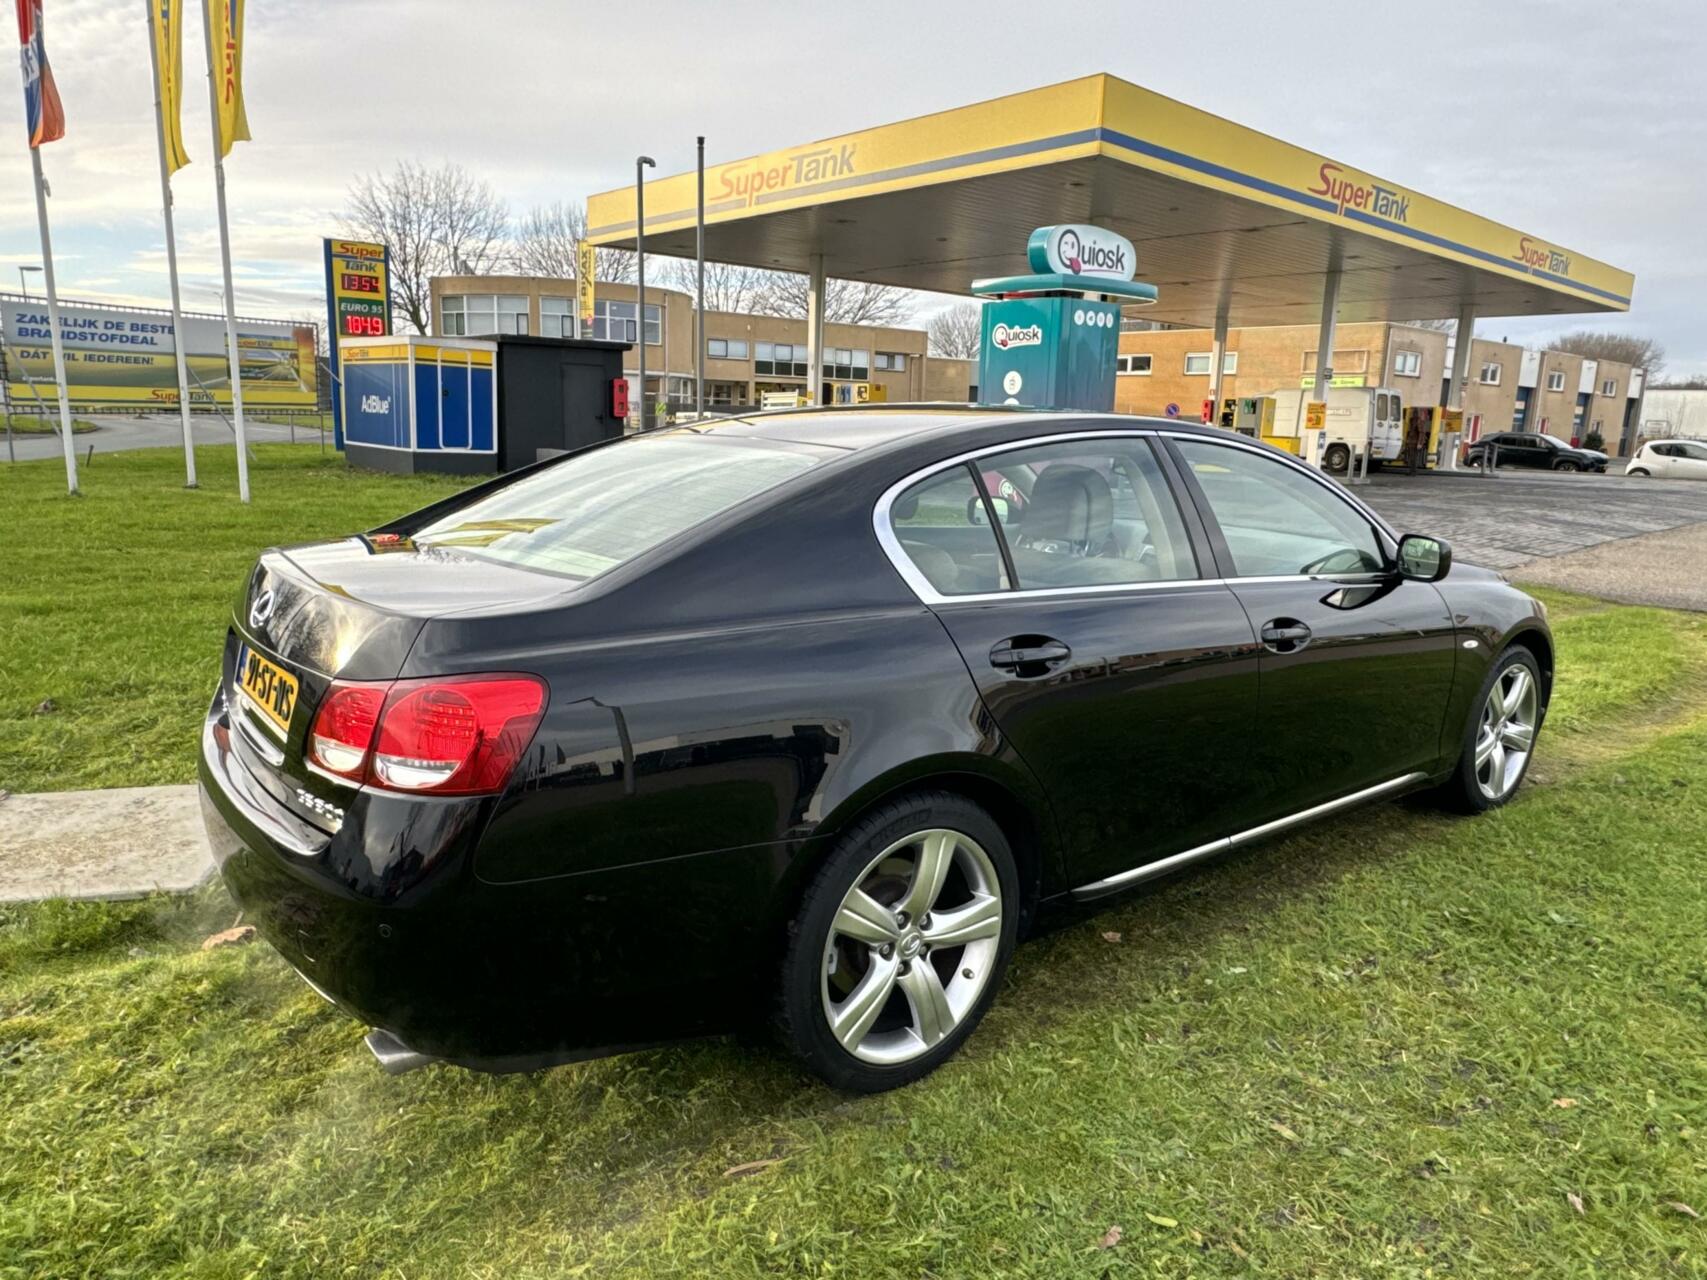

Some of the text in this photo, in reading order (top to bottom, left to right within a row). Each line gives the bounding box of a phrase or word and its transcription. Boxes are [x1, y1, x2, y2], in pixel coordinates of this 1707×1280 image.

[709, 143, 857, 207] SuperTank
[1307, 163, 1410, 222] SuperTank
[338, 242, 384, 260] Super
[1058, 229, 1125, 273] Quiosk
[1512, 237, 1570, 275] SuperTank
[342, 260, 376, 272] Tank
[340, 303, 383, 314] EURO 95
[17, 327, 158, 346] BRADSTOFDEAL
[104, 320, 125, 331] DE
[130, 323, 175, 335] BESTE
[994, 325, 1039, 347] Quiosk
[84, 353, 154, 365] IEDEREEN!
[147, 389, 216, 404] SupeTank
